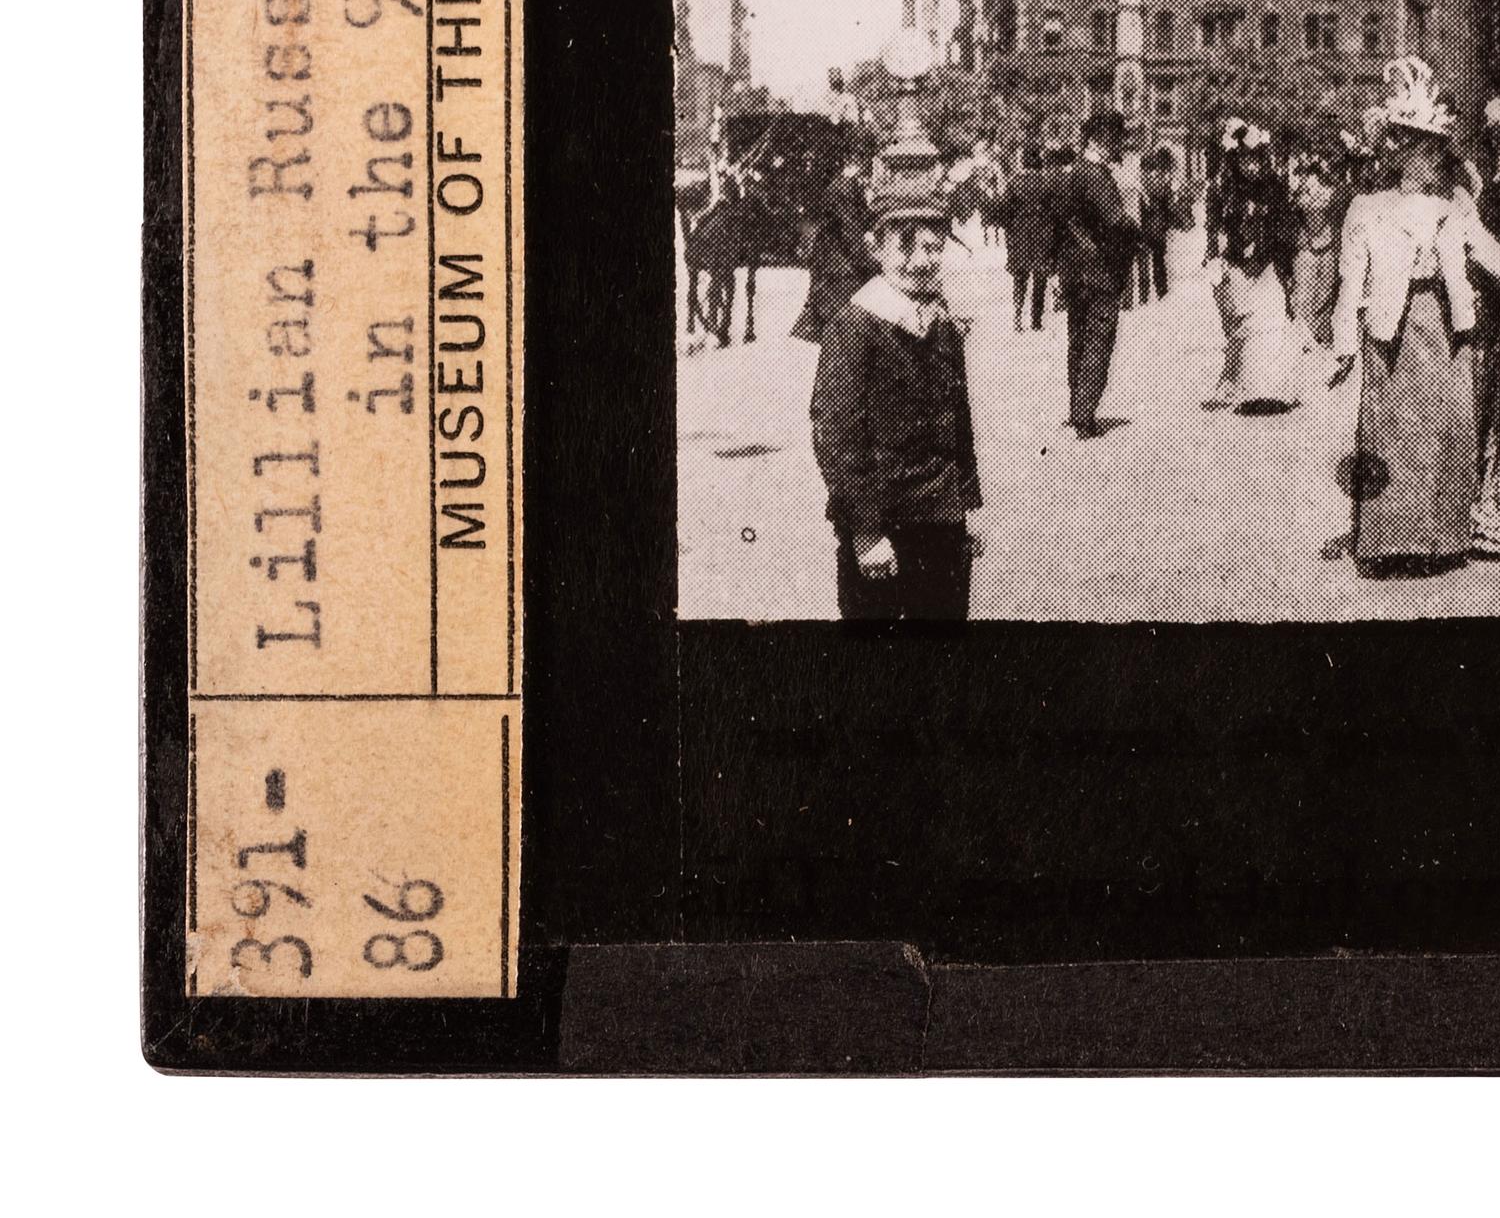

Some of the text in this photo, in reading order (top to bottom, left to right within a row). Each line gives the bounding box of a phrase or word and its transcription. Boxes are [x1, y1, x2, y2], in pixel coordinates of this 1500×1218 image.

[346, 102, 416, 253] the
[434, 131, 485, 217] OF
[346, 316, 415, 416] in
[437, 253, 487, 551] MUSEUM
[248, 258, 323, 650] Lillian
[230, 768, 314, 979] 391-
[362, 879, 445, 972] 86
